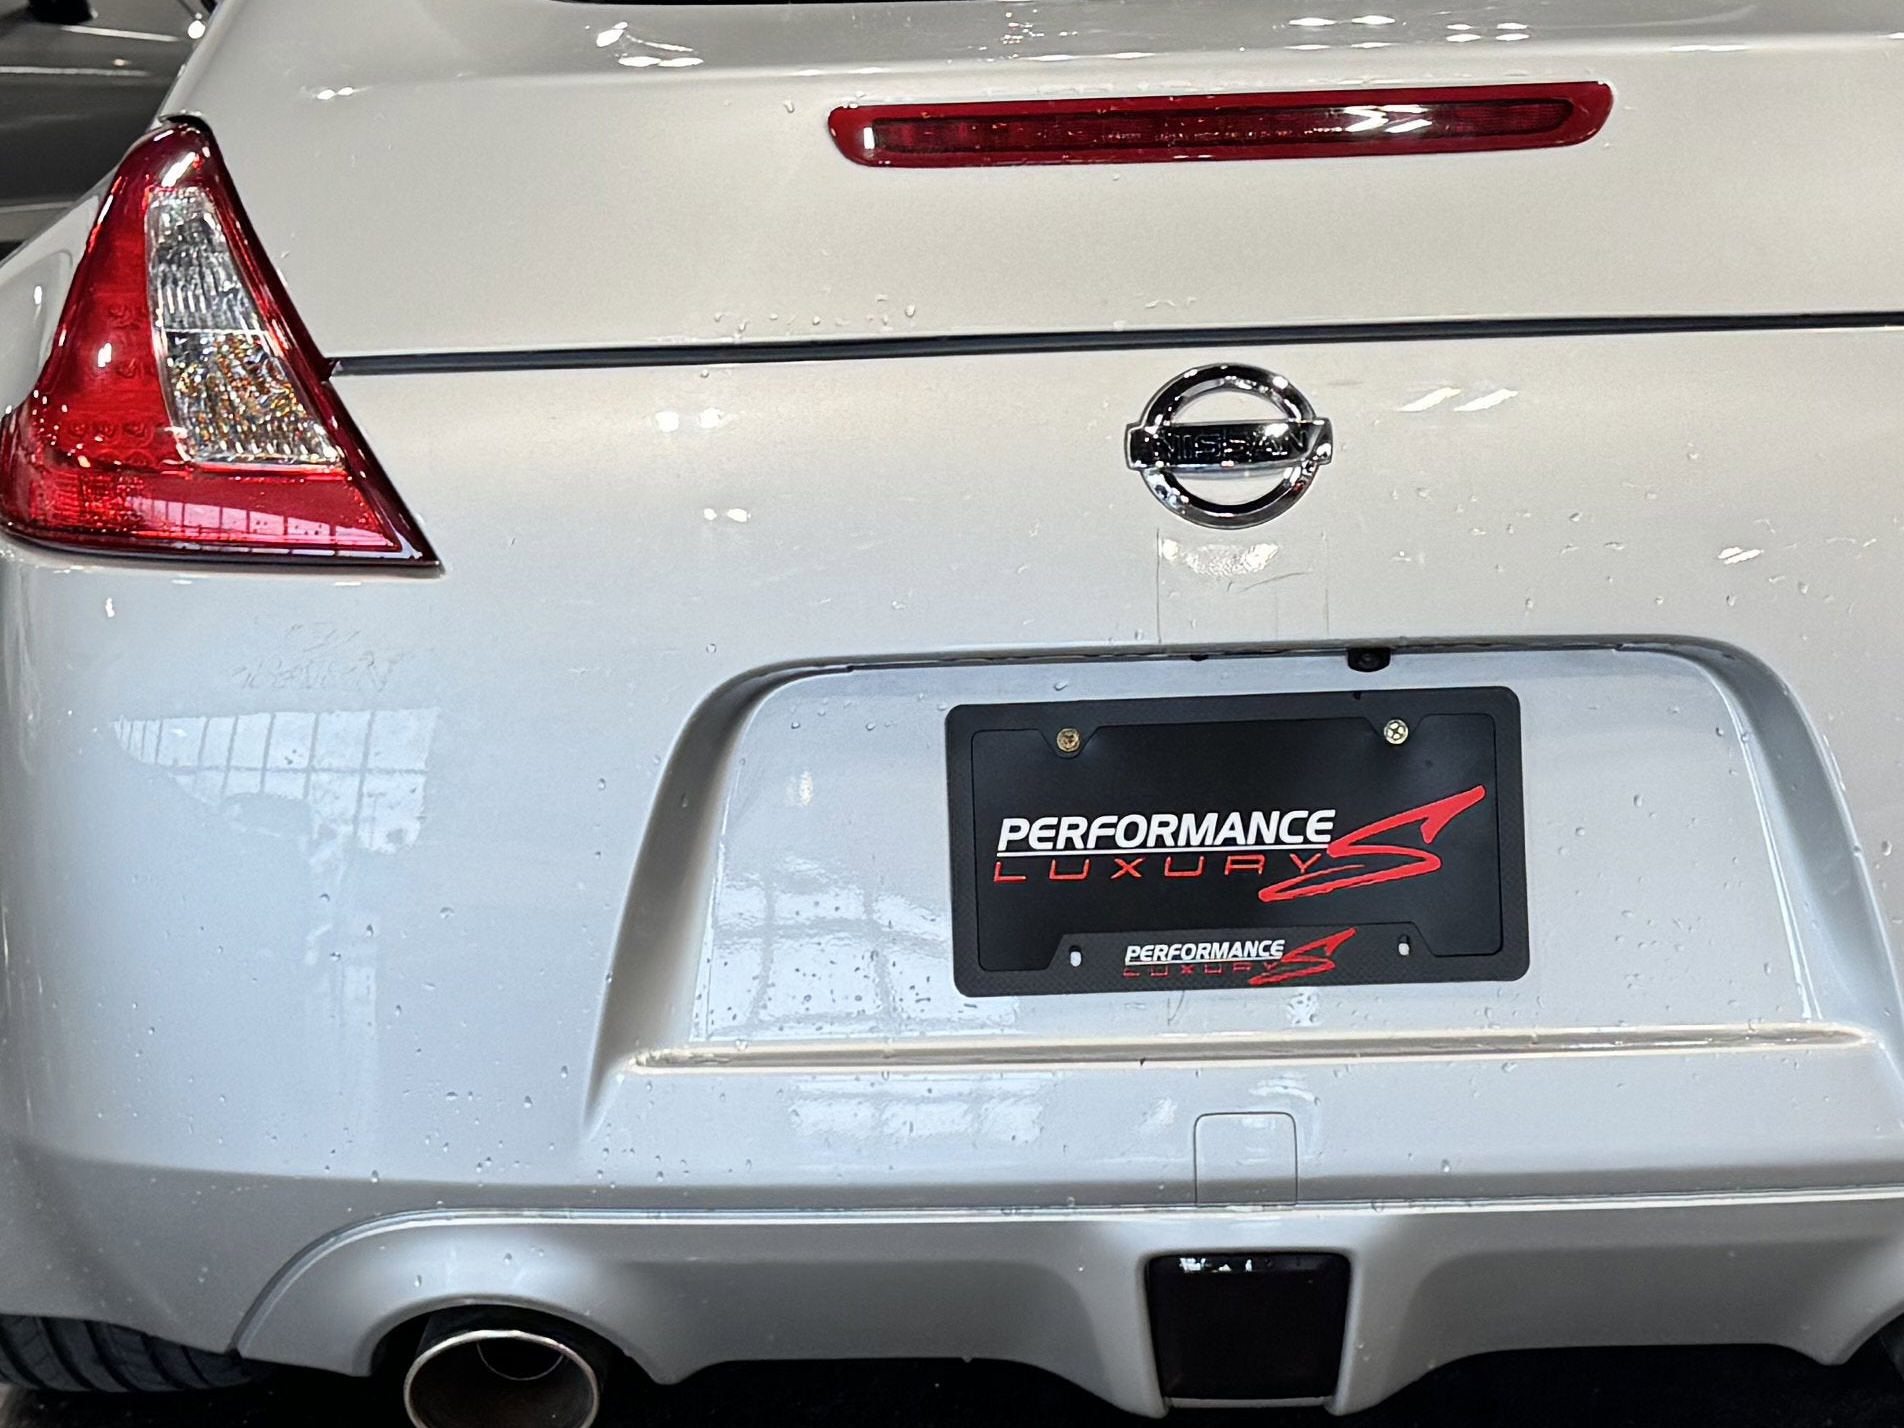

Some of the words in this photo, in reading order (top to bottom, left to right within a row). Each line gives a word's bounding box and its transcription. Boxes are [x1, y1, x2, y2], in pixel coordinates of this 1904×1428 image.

[1157, 425, 1309, 461] NISSAN
[996, 809, 1336, 852] PERFORMANCE
[993, 852, 1323, 883] LUXURY
[1125, 939, 1286, 963] PERFORMANCE
[1122, 960, 1278, 978] LUXURY
